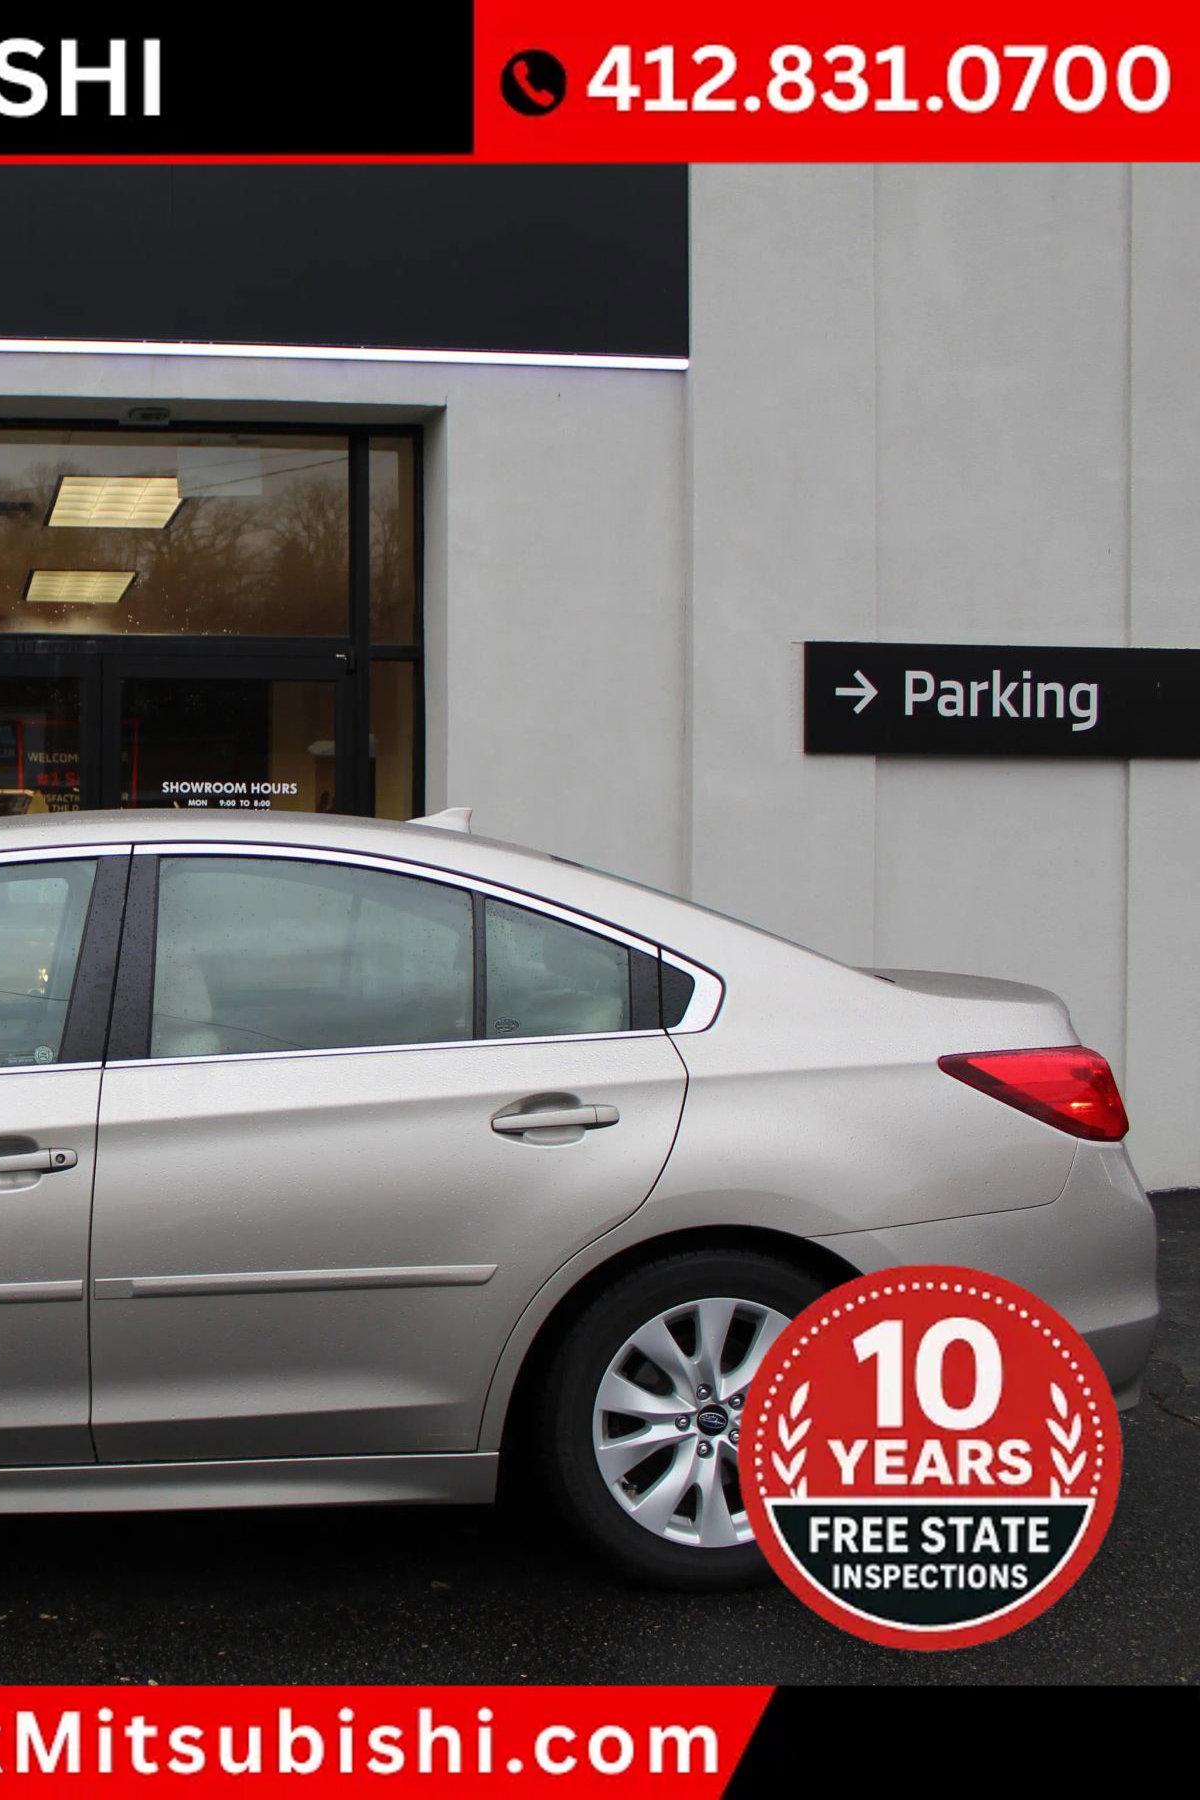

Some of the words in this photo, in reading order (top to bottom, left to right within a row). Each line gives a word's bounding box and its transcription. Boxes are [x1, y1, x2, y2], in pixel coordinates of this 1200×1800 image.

[904, 670, 1098, 731] Parking
[27, 752, 80, 764] WELCOM
[162, 781, 247, 794] SHOWROOM
[251, 782, 298, 795] HOURS
[188, 799, 208, 807] MON
[240, 799, 250, 807] TO
